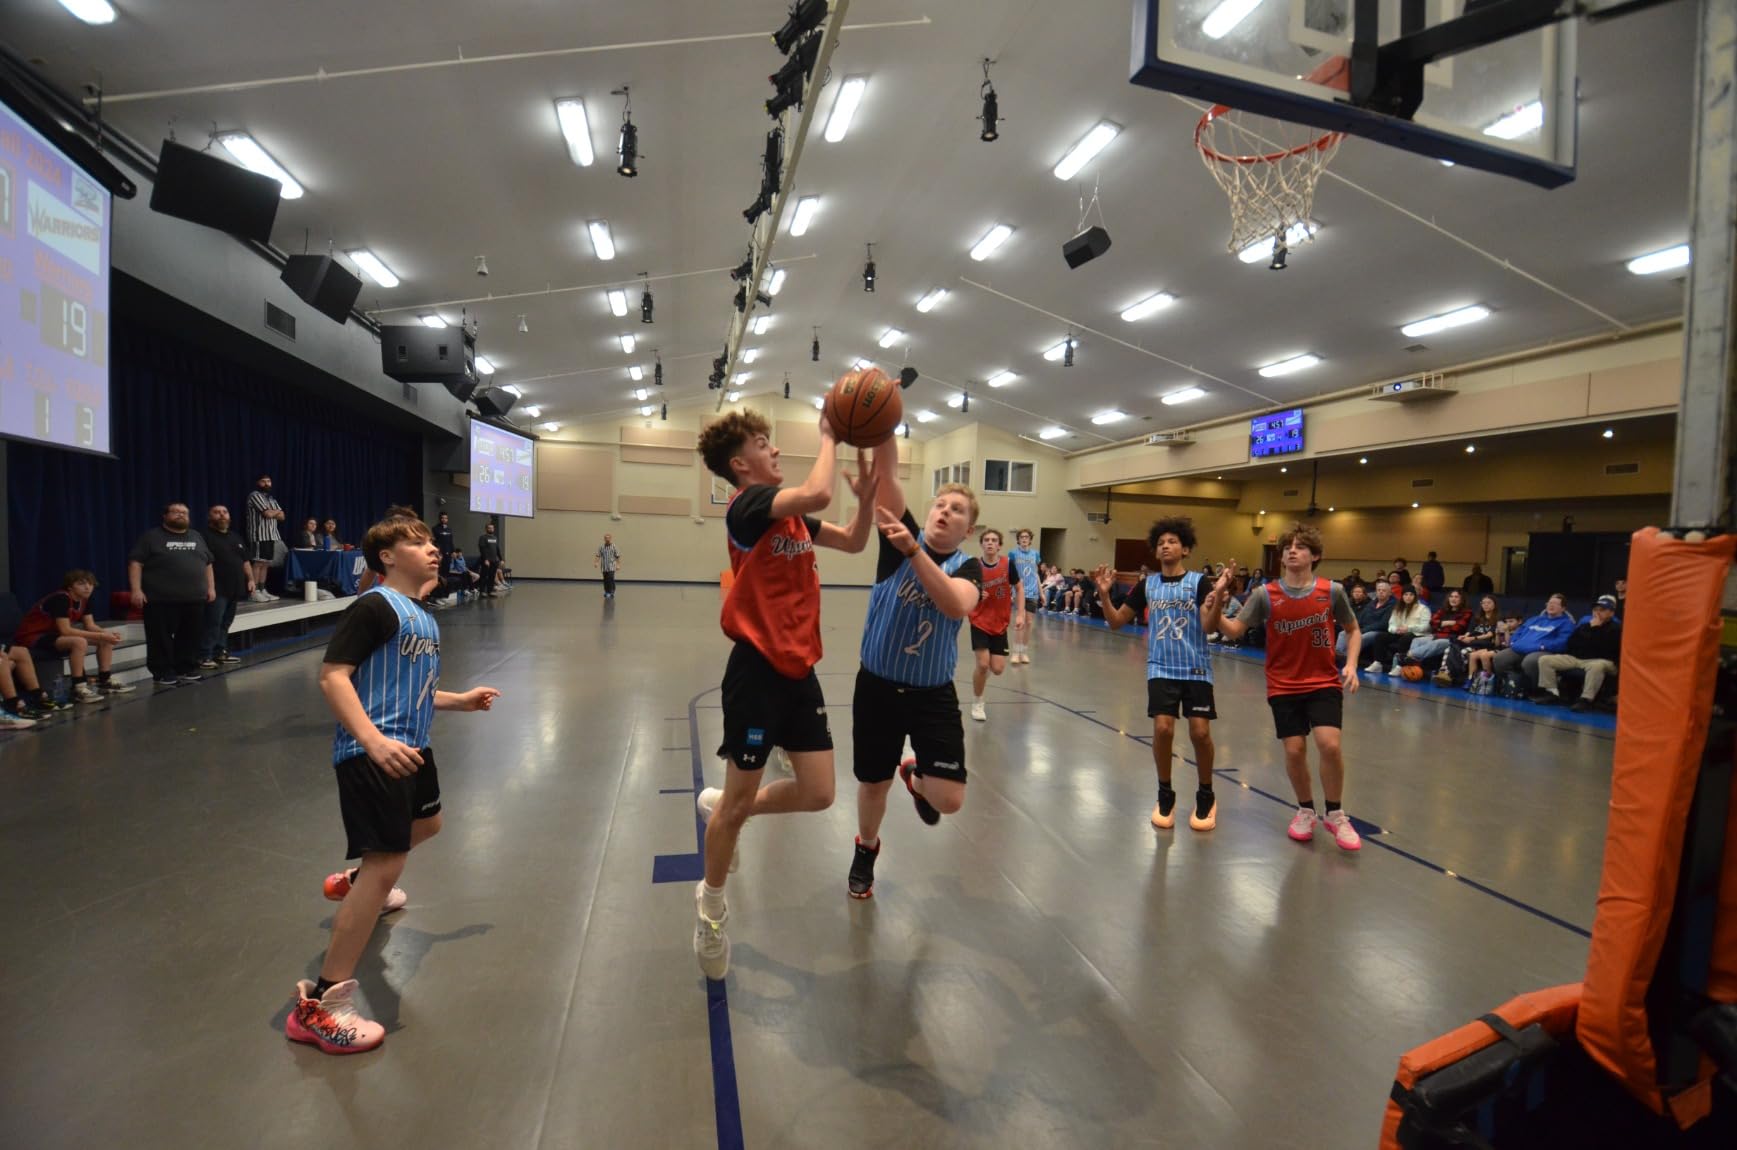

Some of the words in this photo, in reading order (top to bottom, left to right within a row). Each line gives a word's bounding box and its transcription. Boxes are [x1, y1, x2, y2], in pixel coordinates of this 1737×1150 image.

[63, 300, 86, 356] 19
[82, 406, 93, 444] 3
[904, 620, 933, 656] 2
[1273, 607, 1330, 636] Upward
